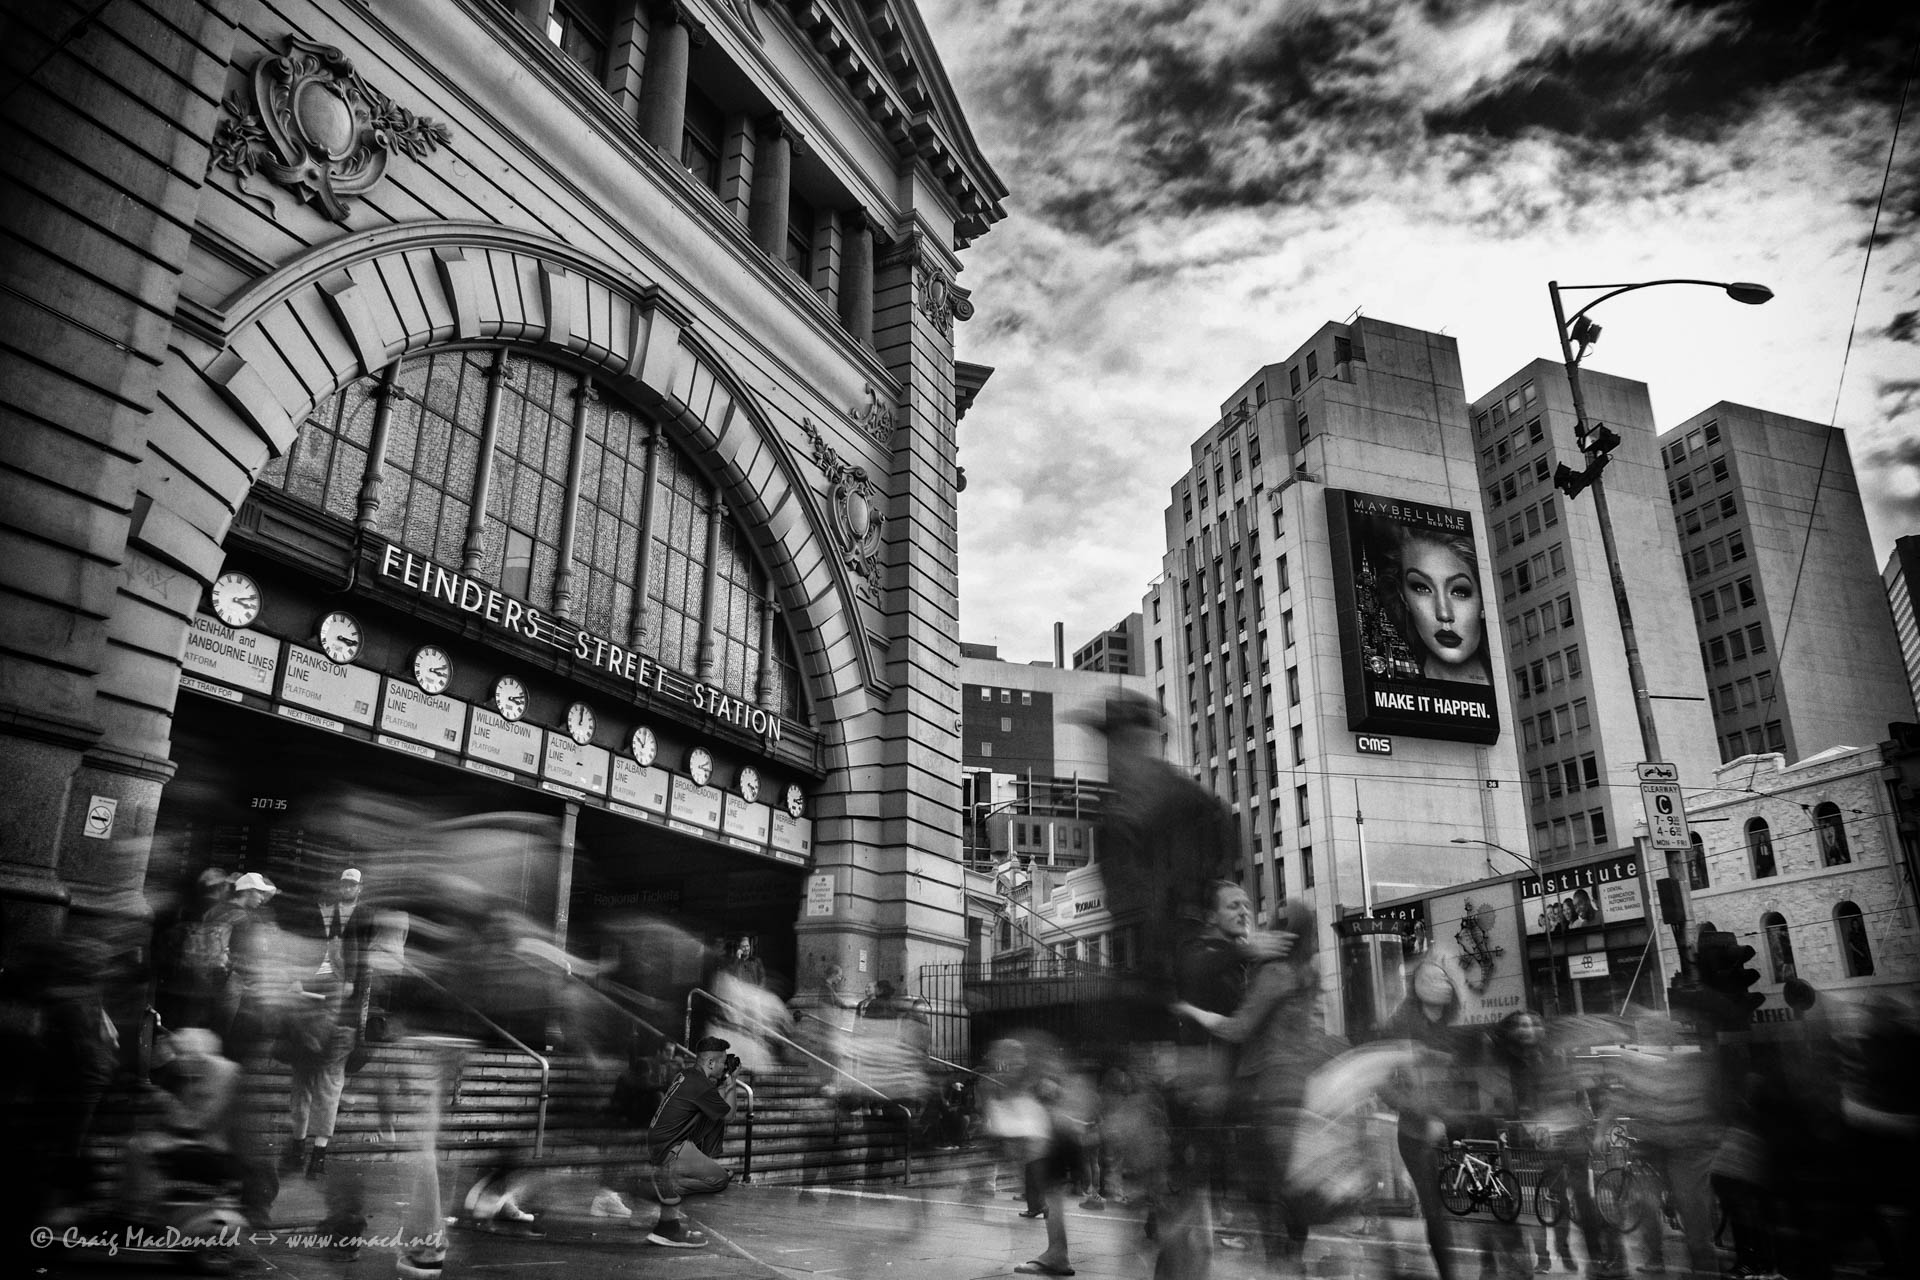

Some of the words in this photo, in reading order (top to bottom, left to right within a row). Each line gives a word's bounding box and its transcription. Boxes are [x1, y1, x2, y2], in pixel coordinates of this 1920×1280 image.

[1354, 499, 1465, 526] MAYBELLINE
[1427, 520, 1444, 528] NEW
[191, 617, 235, 641] KENHAM
[239, 635, 256, 648] and
[382, 544, 540, 639] FLINDERS
[575, 631, 668, 692] STREET
[693, 683, 781, 741] STATION
[247, 652, 275, 671] LINES
[290, 650, 348, 678] FRANKSTON
[287, 665, 310, 682] LINE
[197, 682, 217, 692] TRAIN
[218, 688, 233, 698] FOR
[285, 683, 322, 701] PLATFORM
[390, 683, 451, 712] SANDRINGHAM
[387, 698, 407, 713] LINE
[1374, 691, 1415, 711] MAKE
[1417, 695, 1430, 712] IT
[1434, 698, 1491, 719] HAPPEN.
[287, 709, 302, 717] NEXT
[304, 713, 321, 724] TRAIN
[322, 719, 335, 728] FOR
[385, 714, 418, 730] PLATFORM
[476, 711, 531, 738] WILLIAMSTOWN
[474, 725, 491, 739] LINE
[386, 737, 400, 747] NEXT
[401, 742, 417, 752] TRAIN
[417, 746, 428, 755] FOR
[551, 736, 577, 754] ALTONA
[549, 749, 564, 762] LINE
[615, 771, 628, 784] LINE
[616, 760, 624, 769] ST
[625, 763, 647, 778] ALBANS
[674, 791, 686, 802] LINE
[675, 780, 718, 801] BROADMEADOWS
[727, 807, 738, 818] LINE
[774, 822, 785, 833] LINE
[1521, 862, 1637, 897] institute
[594, 890, 640, 907] Regional
[1481, 995, 1520, 1008] PHILLIP
